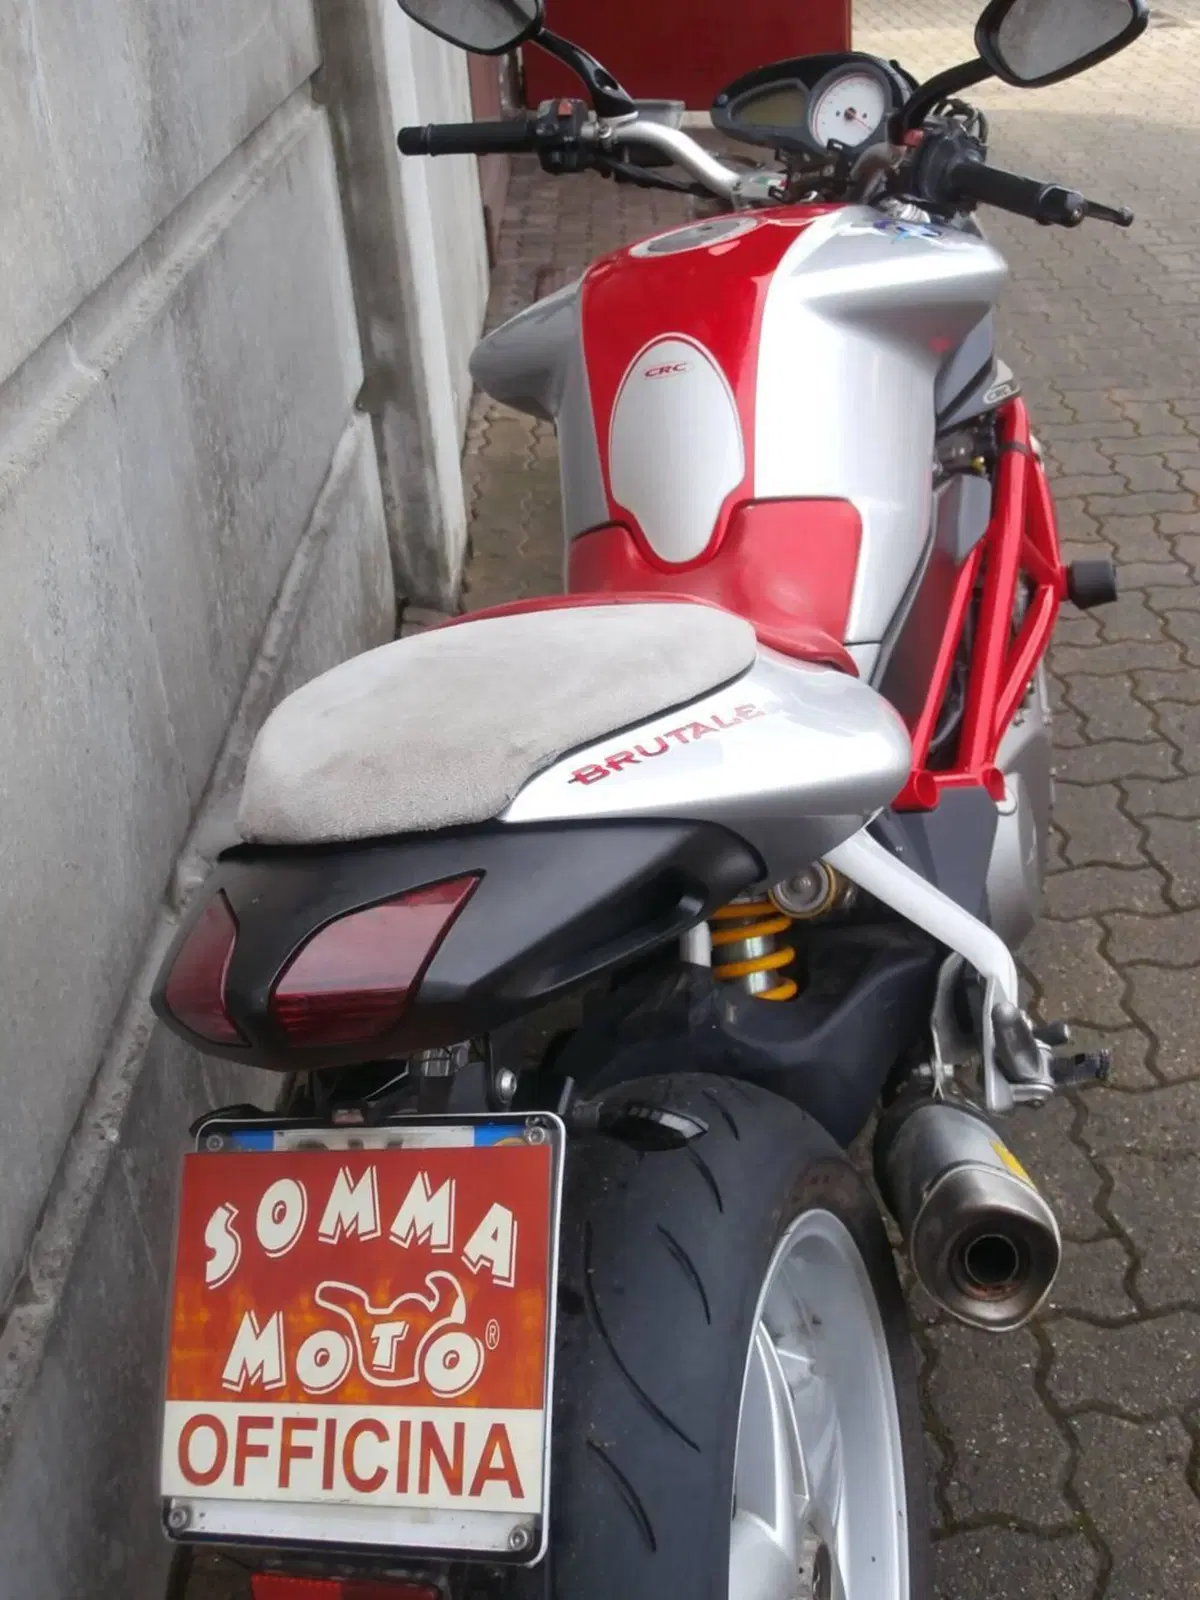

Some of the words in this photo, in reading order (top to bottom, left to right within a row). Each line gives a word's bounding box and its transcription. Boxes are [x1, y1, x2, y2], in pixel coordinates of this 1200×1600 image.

[645, 361, 688, 377] CRC
[568, 703, 765, 785] BRUTALE
[205, 1165, 518, 1289] SOMMA
[222, 1310, 484, 1398] MOTO
[178, 1413, 525, 1499] OFFICINA
